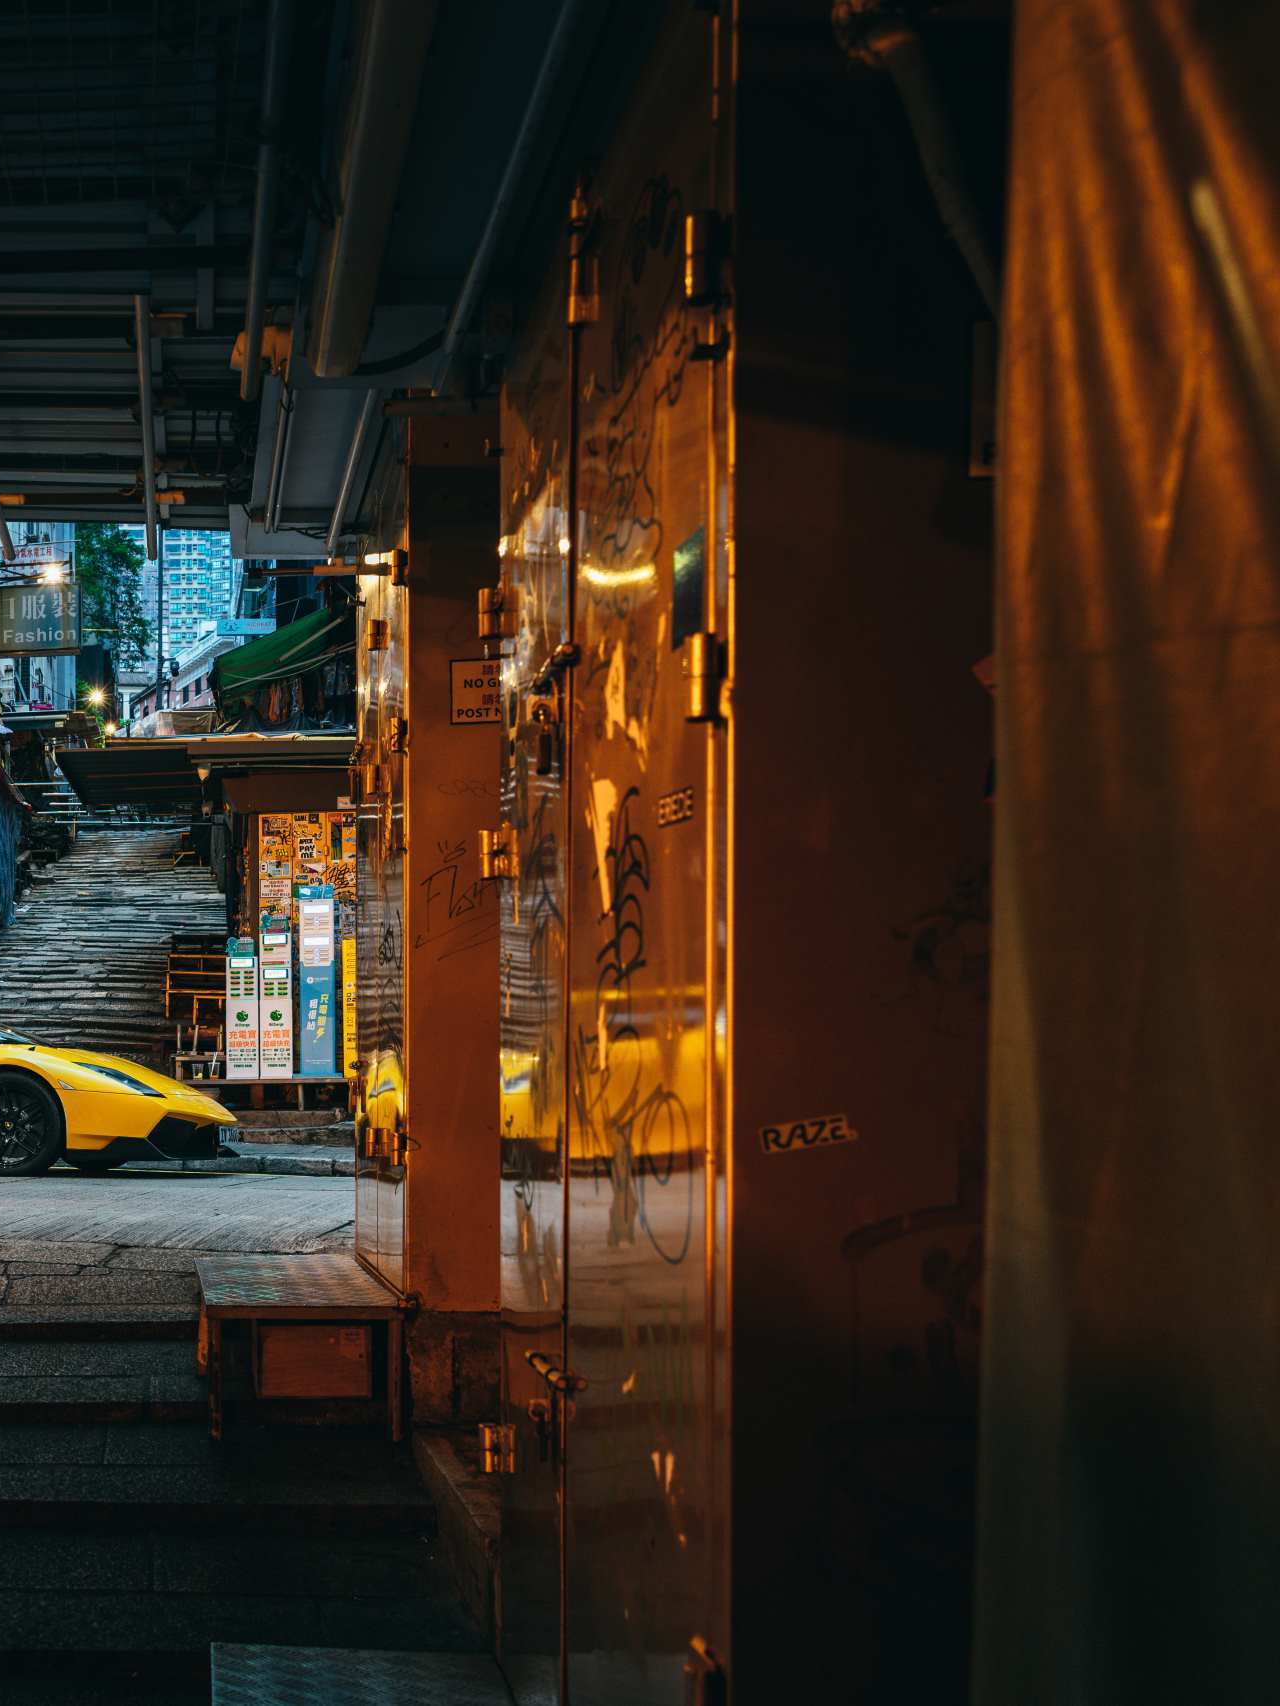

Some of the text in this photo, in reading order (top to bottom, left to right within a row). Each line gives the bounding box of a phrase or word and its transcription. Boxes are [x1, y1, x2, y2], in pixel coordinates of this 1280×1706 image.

[3, 627, 77, 644] Fashion
[463, 678, 484, 689] NO
[457, 707, 490, 719] POST
